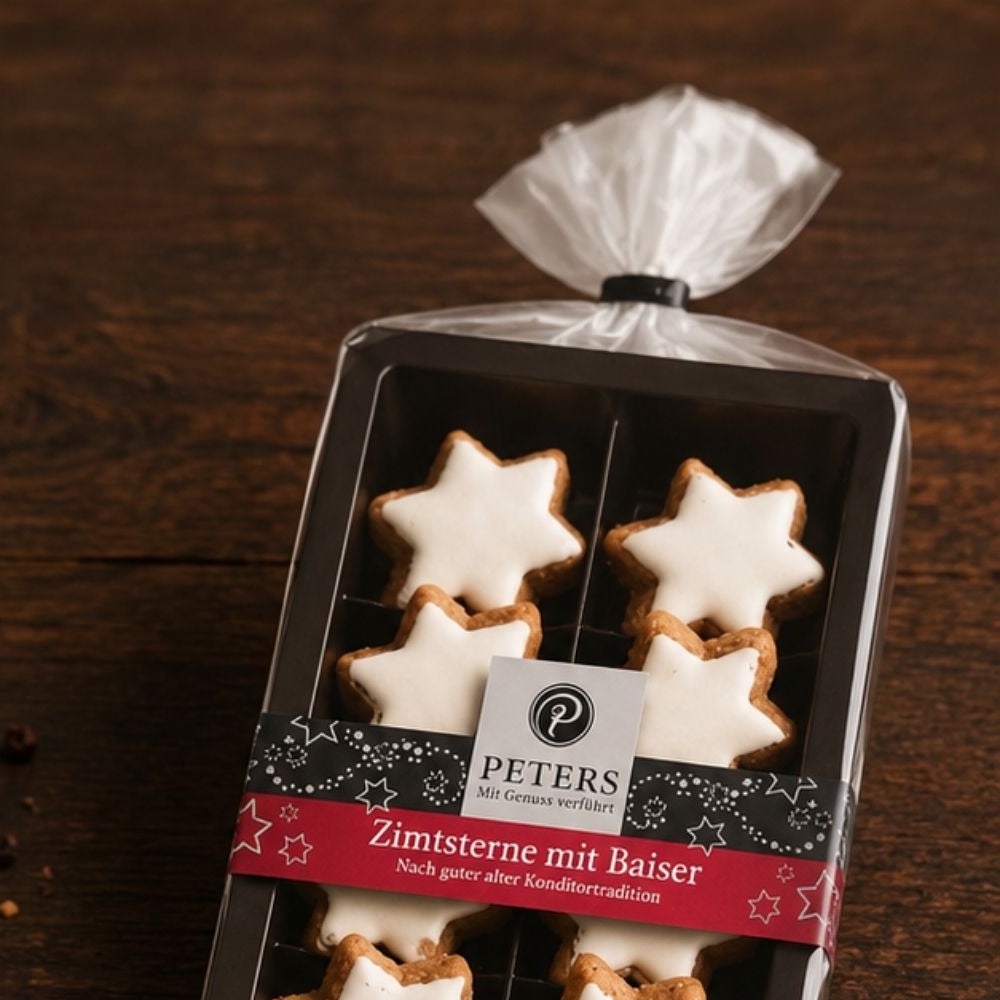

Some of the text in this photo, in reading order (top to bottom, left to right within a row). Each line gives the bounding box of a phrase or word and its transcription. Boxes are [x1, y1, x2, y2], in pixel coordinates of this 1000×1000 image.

[479, 755, 620, 796] PETERS
[476, 785, 615, 815] Mit Genuss verführt
[368, 818, 703, 886] Zimtsterne mit Baiser
[395, 858, 662, 904] Nach guter alter Konditortradition
